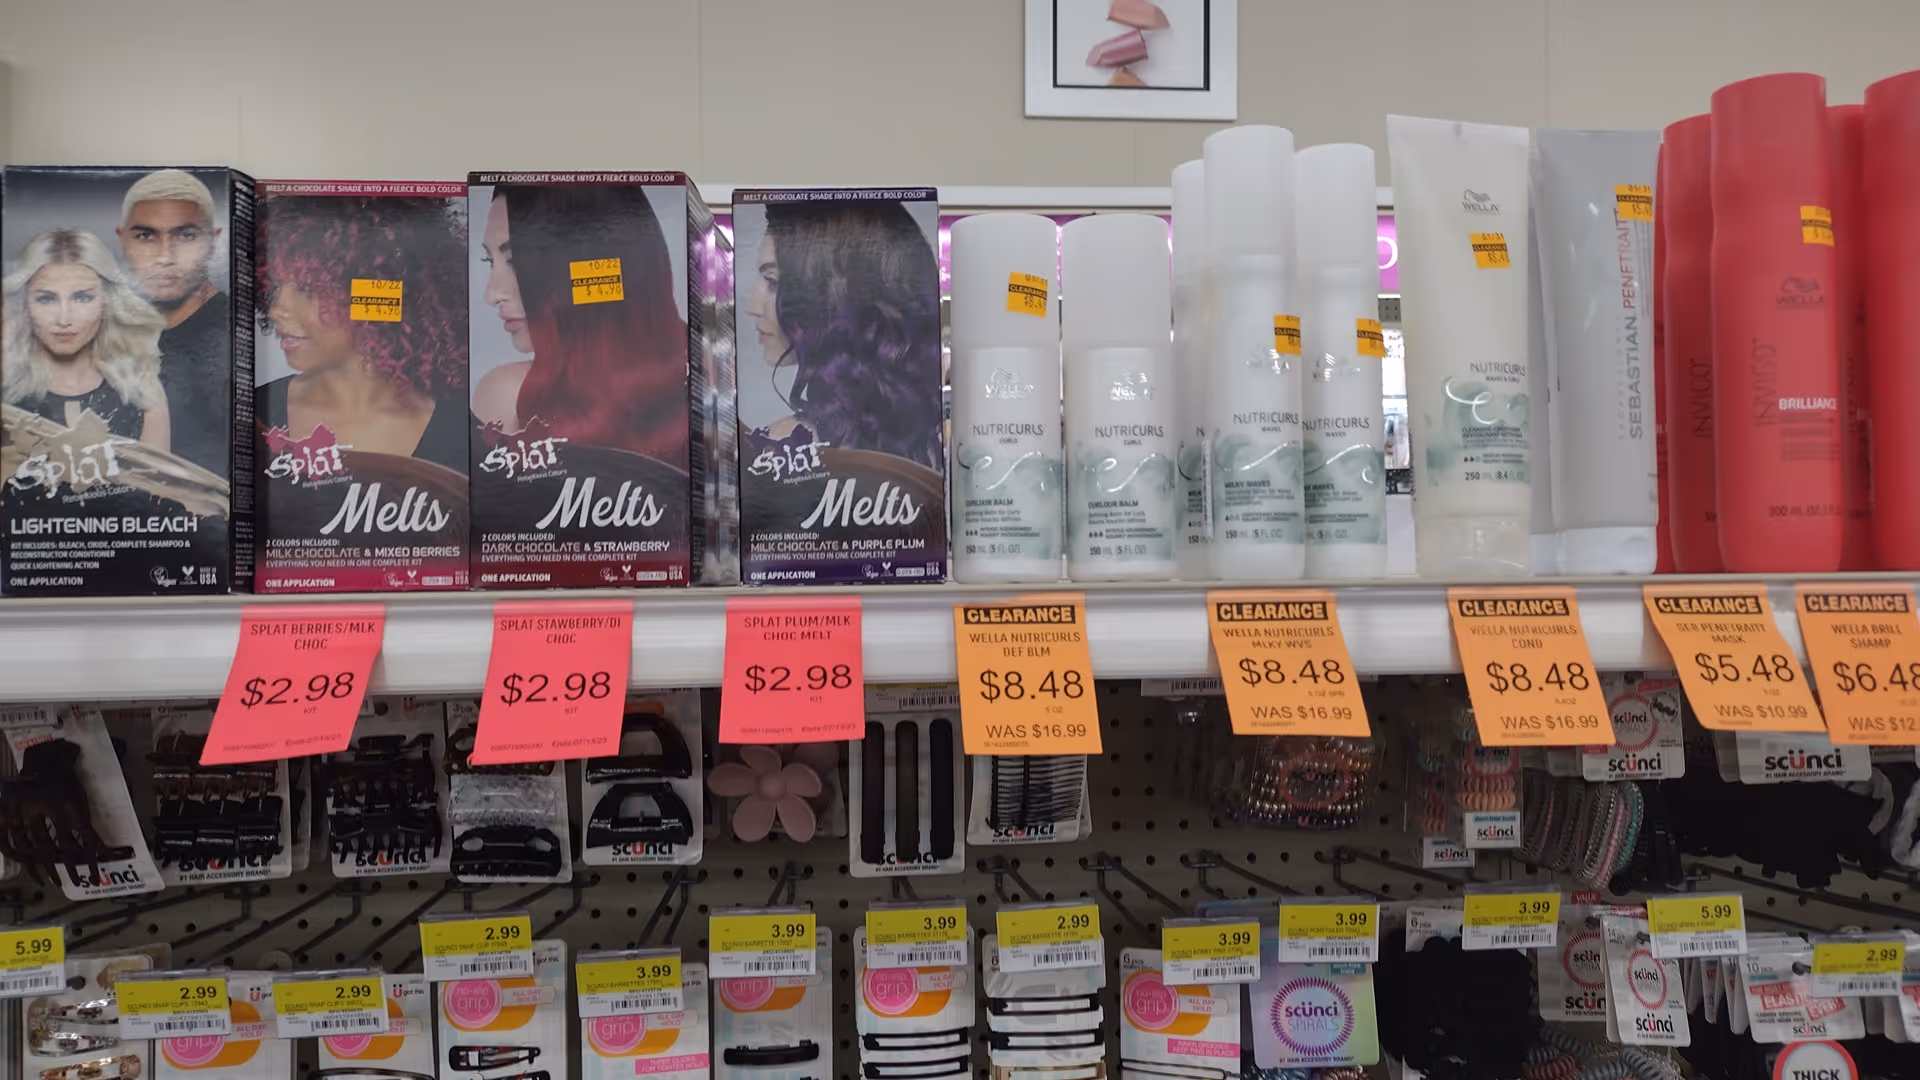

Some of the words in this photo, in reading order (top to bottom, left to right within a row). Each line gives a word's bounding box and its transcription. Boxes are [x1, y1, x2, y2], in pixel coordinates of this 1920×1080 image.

[603, 174, 628, 182] FIERCE
[1462, 202, 1498, 212] WELLA
[573, 276, 618, 286] CLEARANCE
[1624, 316, 1643, 440] SEBASTIAN
[1233, 412, 1299, 424] NUTRICURLS
[1302, 418, 1370, 430] NUTRICURLS
[973, 424, 1043, 435] NUTRICURLS
[1095, 425, 1164, 437] NUTRICURLS
[320, 482, 450, 534] Melts
[535, 477, 664, 529] Melts
[801, 478, 920, 529] Melts
[11, 517, 119, 534] LIGHTENING
[122, 516, 197, 533] BLEACH
[482, 542, 512, 553] DARK
[514, 542, 580, 552] CHOCOLATE
[584, 543, 590, 551] &
[594, 541, 669, 551] STRAWBERRY
[751, 542, 775, 551] MILK
[778, 541, 838, 550] CHOCOLATE
[842, 541, 848, 549] &
[852, 540, 892, 549] PURPLE
[895, 539, 924, 549] PLUM
[266, 548, 292, 558] MILK
[294, 548, 361, 558] CHOCOLATE
[364, 549, 371, 557] &
[375, 547, 410, 557] MIXED
[412, 546, 460, 557] BERRIES
[482, 554, 525, 562] EVERYTHING
[526, 554, 541, 562] YOU
[588, 553, 624, 561] COMPLETE
[626, 553, 637, 561] KIT
[11, 562, 31, 570] QUICK
[33, 561, 71, 569] LIGHTENING
[73, 561, 99, 569] ACTION
[10, 578, 29, 586] ONE
[30, 577, 83, 586] APPLICATION
[200, 574, 217, 585] USA
[482, 574, 497, 582] ONE
[500, 574, 550, 582] APPLICATION
[669, 571, 683, 580] USA
[769, 571, 815, 579] APPLICATION
[266, 579, 282, 588] ONE
[283, 579, 335, 588] APPLICATION
[1461, 600, 1567, 616] CLEARANCE
[1658, 598, 1759, 613] CLEARANCE
[1807, 595, 1907, 611] CLEARANCE
[967, 607, 1072, 623] CLEARANCE
[1219, 603, 1324, 620] CLEARANCE
[500, 619, 533, 631] SPLAT
[744, 616, 781, 628] SPLAT
[785, 615, 851, 627] PLUM/MLK
[251, 624, 287, 635] SPLAT
[291, 622, 375, 635] BERRIES/MLK
[1223, 628, 1261, 637] WELLA
[1264, 627, 1335, 637] NUTRICURLS
[1470, 626, 1507, 635] WELLA
[1510, 625, 1577, 635] NUTRICURLS
[1831, 624, 1869, 635] WELLA
[1872, 624, 1903, 635] BRILL
[546, 633, 576, 644] CHOC
[763, 631, 797, 641] CHOC
[801, 630, 832, 640] MELT
[970, 633, 1008, 643] WELLA
[1011, 632, 1081, 642] NUTRICURLS
[1712, 634, 1747, 644] MASK
[294, 638, 328, 650] CHOC
[1252, 640, 1282, 648] MLKY
[1285, 640, 1312, 648] WVS
[1511, 639, 1543, 648] COND
[1850, 638, 1891, 648] SHAMP
[1003, 647, 1025, 657] DEF
[1028, 647, 1050, 657] BLM
[1239, 657, 1344, 688] $8.48
[1695, 652, 1794, 685] $5.48
[745, 664, 852, 694] $2.98
[1486, 661, 1589, 695] $8.48
[240, 671, 354, 709] $2.98
[500, 671, 611, 707] $2.98
[980, 669, 1084, 704] $8.48
[1251, 706, 1293, 719] WAS
[1297, 706, 1352, 720] $16.99
[1714, 705, 1754, 718] WAS
[1756, 705, 1808, 718] $10.99
[1500, 716, 1541, 729] WAS
[1545, 715, 1599, 730] $16.99
[1848, 717, 1885, 731] WAS
[986, 725, 1027, 738] WAS
[1032, 724, 1086, 739] $16.99
[1609, 752, 1661, 772] scünci
[1765, 749, 1843, 770] scünci
[1519, 901, 1550, 914] 3.99
[1701, 904, 1731, 919] 5.99
[924, 916, 957, 930] 3.99
[1057, 915, 1090, 930] 2.99
[1335, 912, 1367, 925] 3.99
[485, 926, 520, 940] 2.99
[772, 924, 805, 938] 3.99
[1219, 932, 1250, 945] 3.99
[16, 939, 52, 955] 5.99
[1867, 949, 1897, 962] 2.99
[637, 965, 672, 979] 3.99
[180, 987, 217, 999] 2.99
[336, 985, 371, 999] 2.99
[1285, 1001, 1338, 1018] scünci
[1792, 1070, 1840, 1080] THICK
